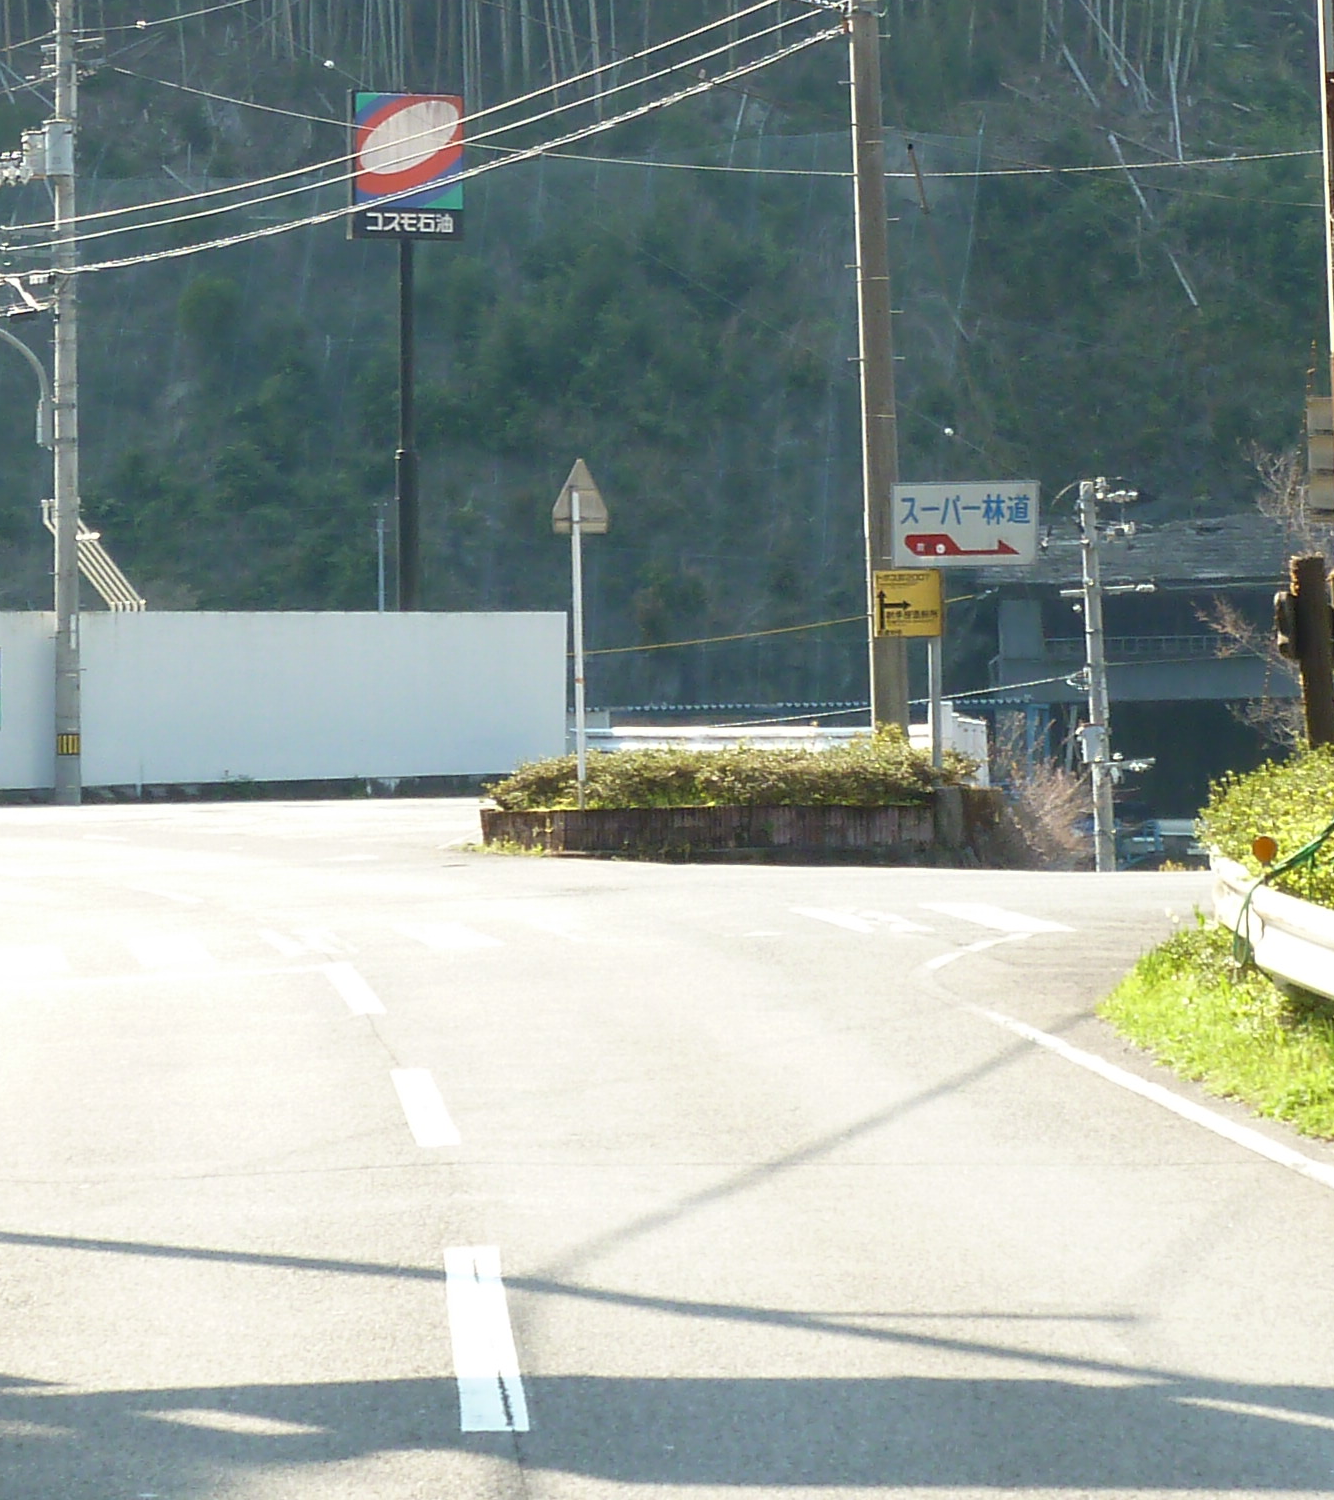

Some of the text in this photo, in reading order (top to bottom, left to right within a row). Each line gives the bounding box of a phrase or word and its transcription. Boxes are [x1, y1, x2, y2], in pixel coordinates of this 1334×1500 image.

[365, 211, 455, 233] コスモ石油
[899, 494, 1031, 526] スーパー林道
